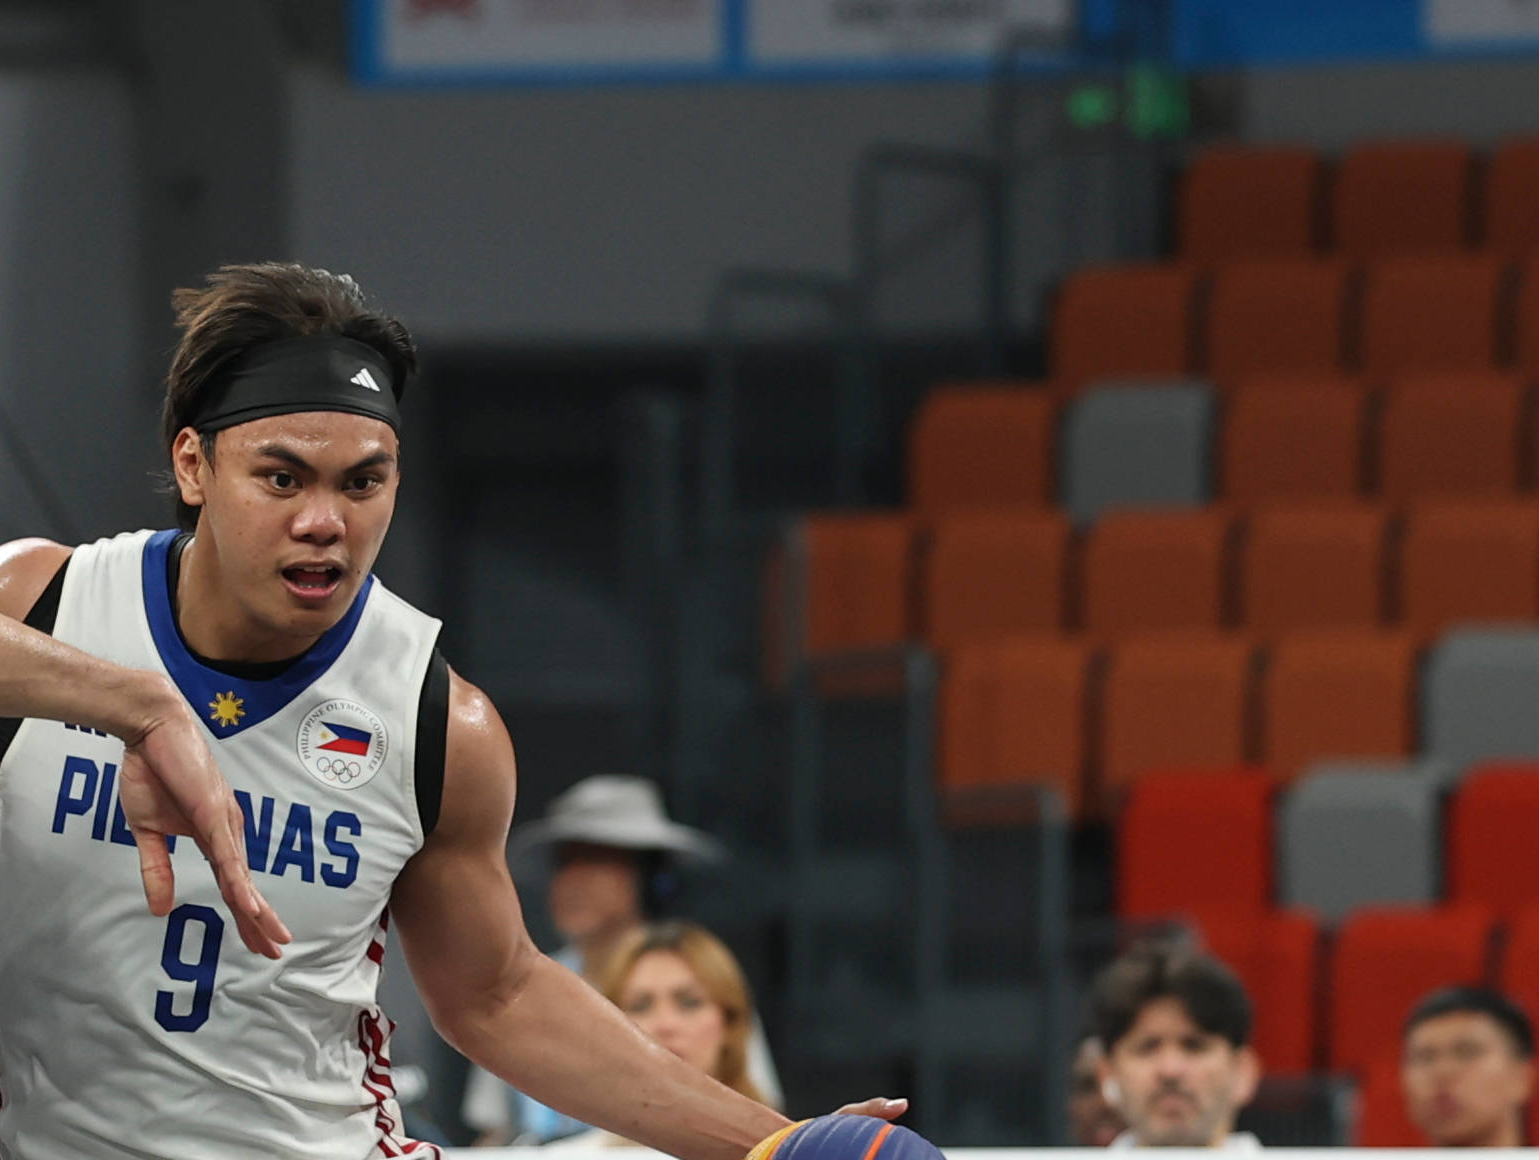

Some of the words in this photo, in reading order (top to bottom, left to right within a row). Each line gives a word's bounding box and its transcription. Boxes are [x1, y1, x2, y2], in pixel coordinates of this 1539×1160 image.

[301, 708, 326, 760] PHILIPPINE
[326, 703, 370, 720] OLYMPIC
[52, 755, 362, 889] PILNAS
[154, 903, 225, 1033] 9
